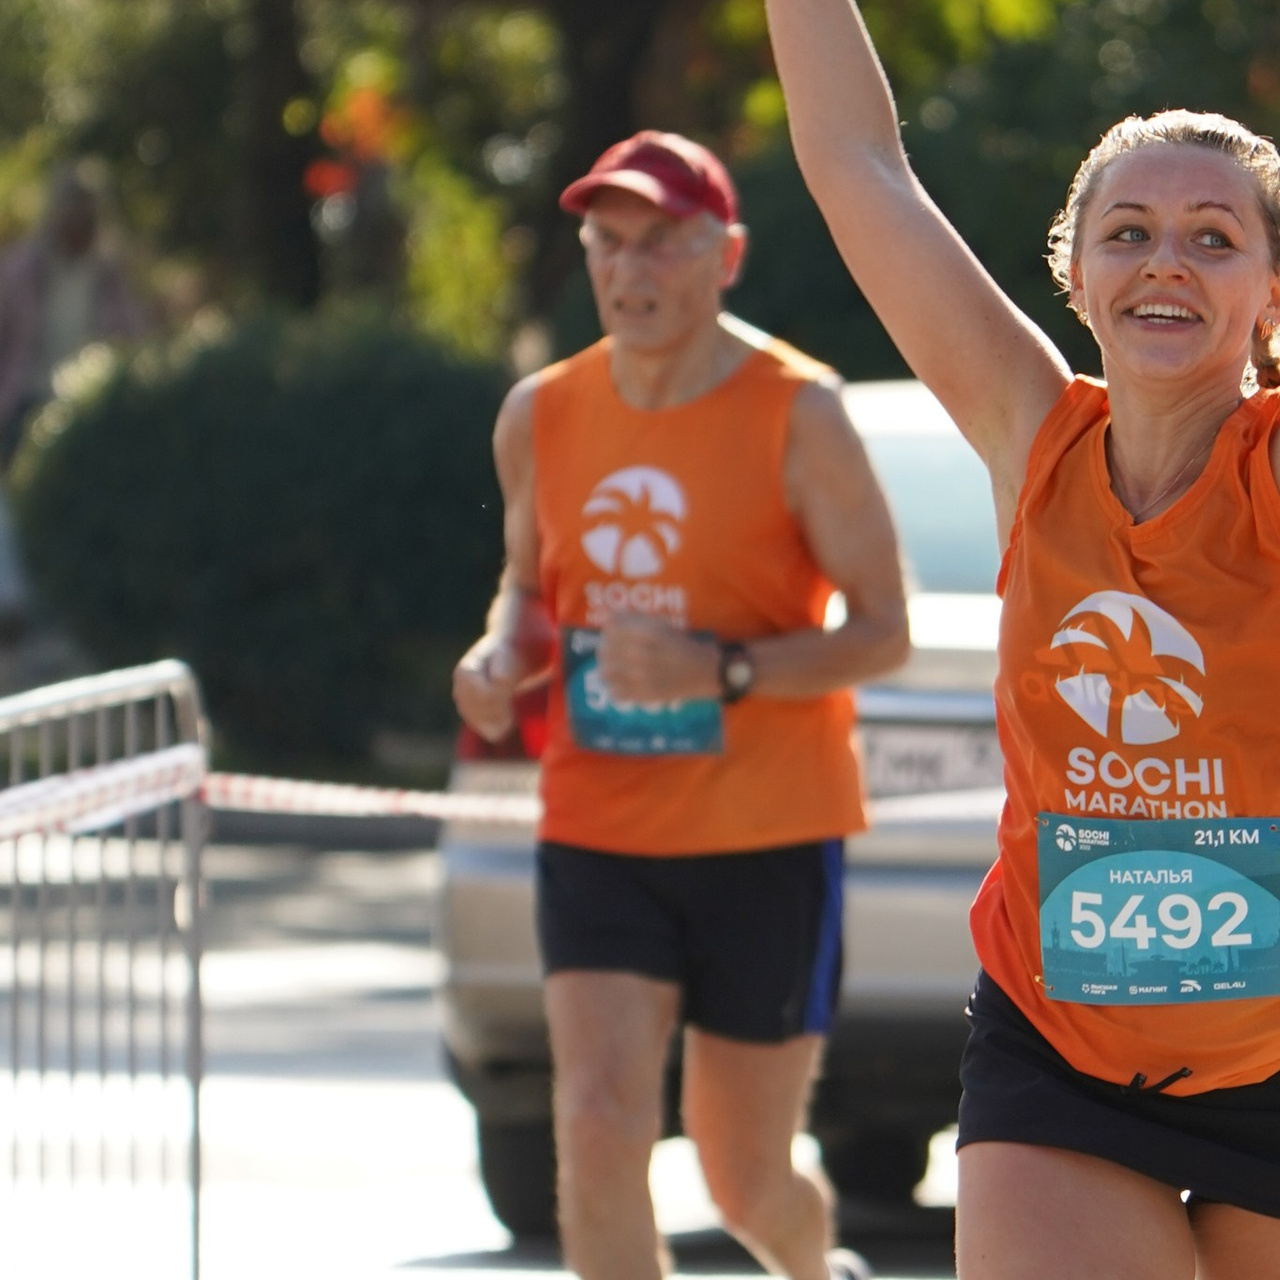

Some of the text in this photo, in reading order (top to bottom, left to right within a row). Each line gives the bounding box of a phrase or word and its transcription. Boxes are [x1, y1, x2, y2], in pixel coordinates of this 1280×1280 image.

[1065, 746, 1225, 796] SOCHI
[1064, 788, 1228, 820] MARATHON
[1078, 829, 1110, 840] SOCHI
[1194, 829, 1225, 848] 21,1
[1109, 869, 1193, 885] НАТАЛЬЯ
[1070, 890, 1253, 950] 5492
